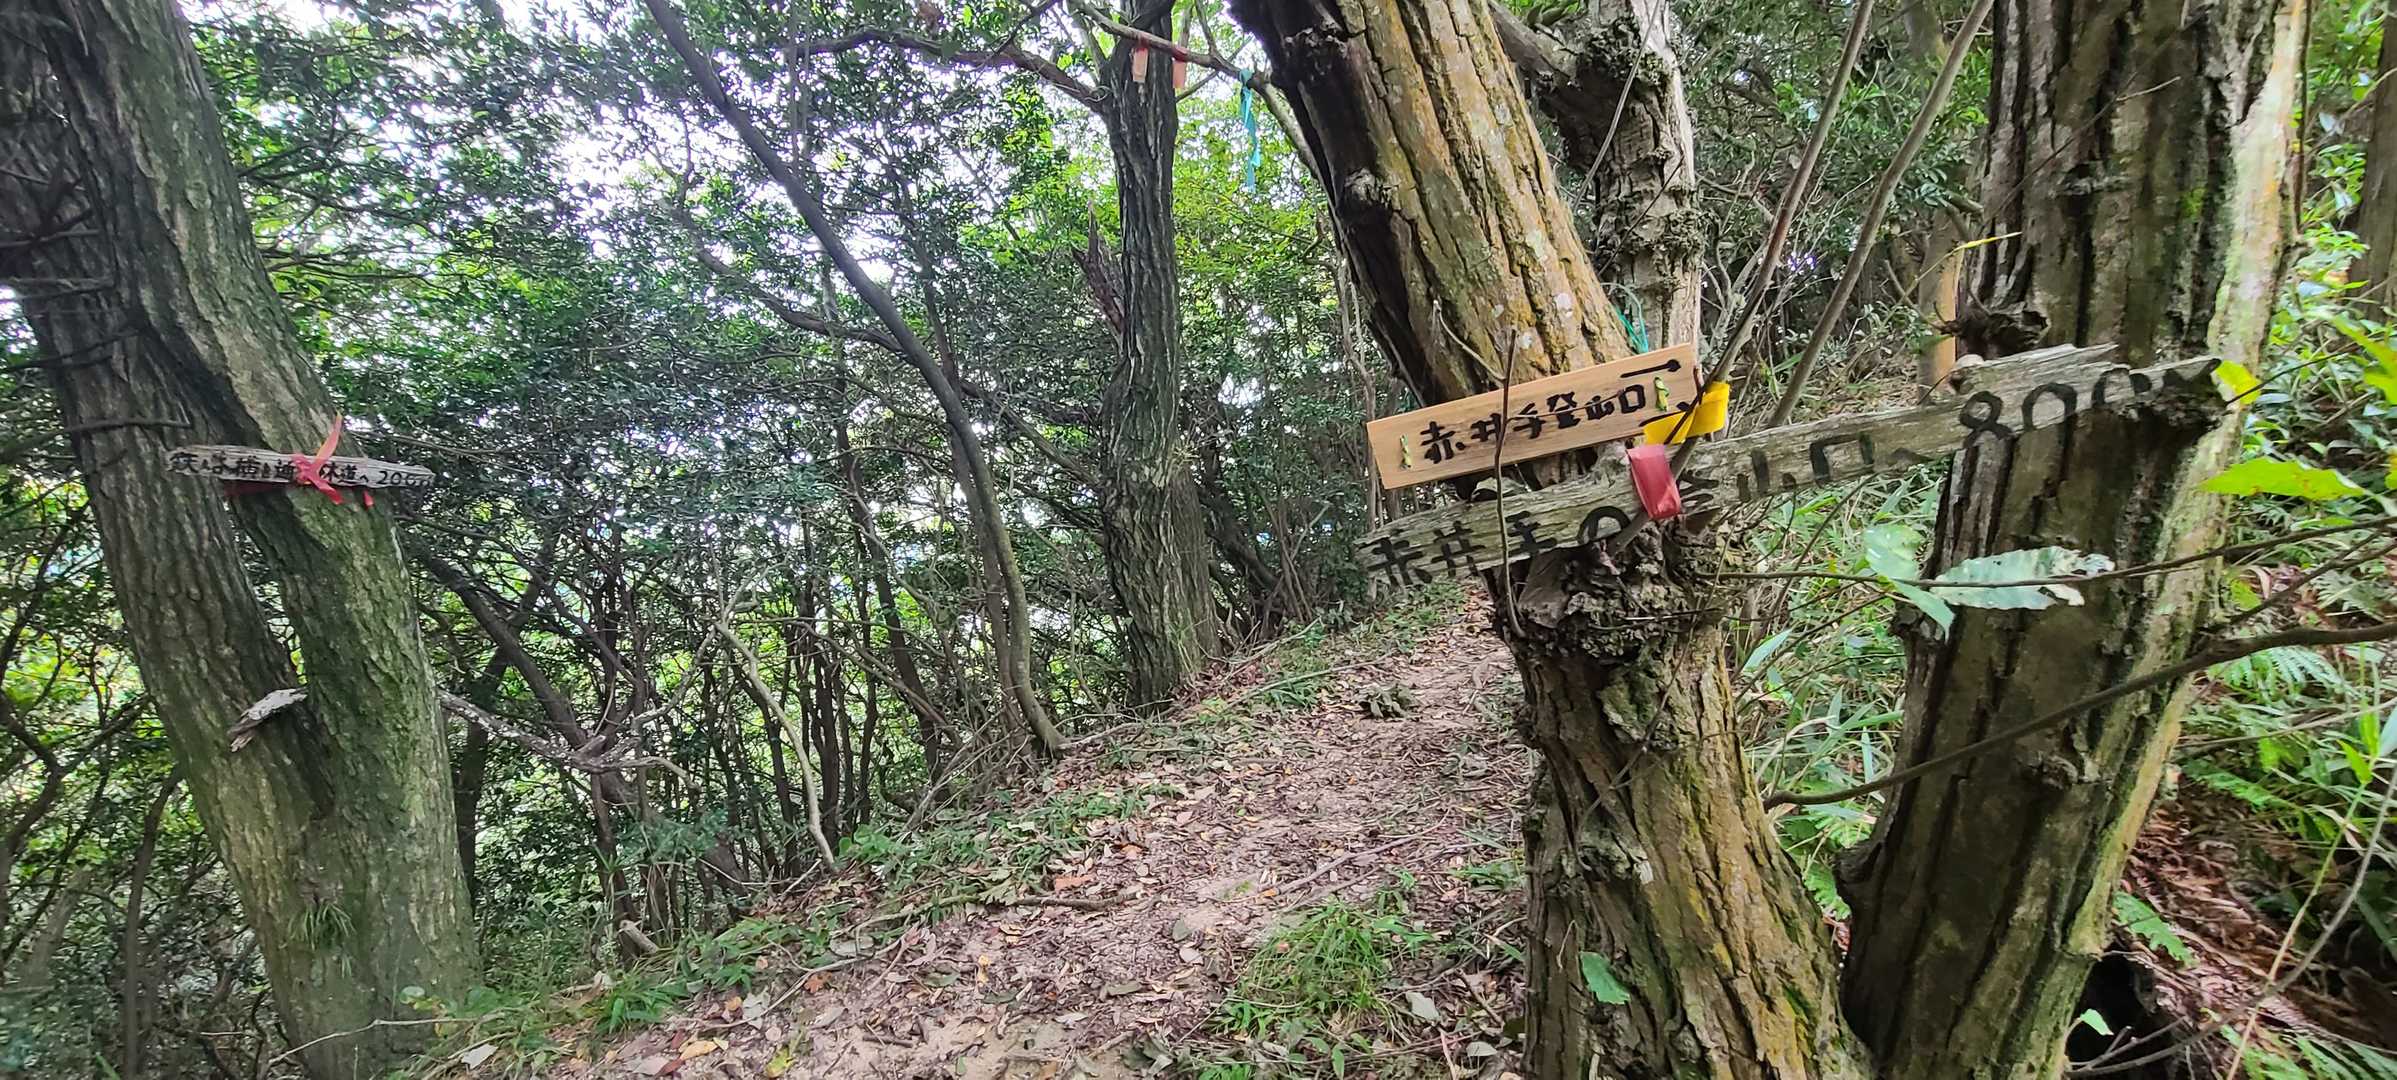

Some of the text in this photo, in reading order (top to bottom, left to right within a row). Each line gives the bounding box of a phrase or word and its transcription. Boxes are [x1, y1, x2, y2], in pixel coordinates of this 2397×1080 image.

[1420, 383, 1647, 465] 赤井手登山口
